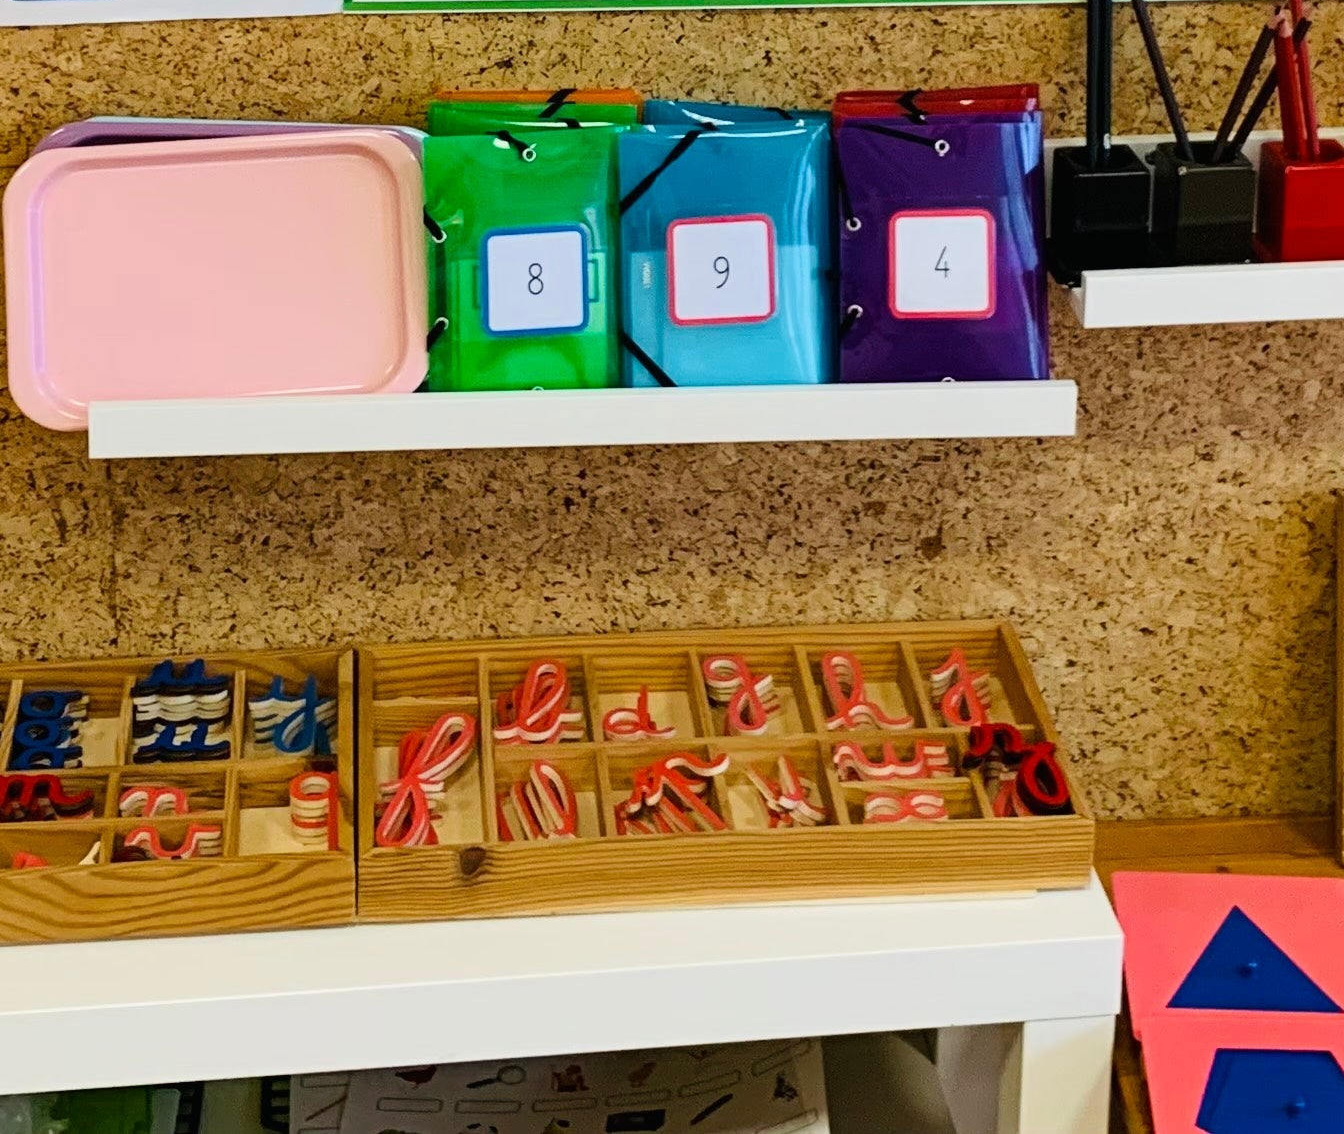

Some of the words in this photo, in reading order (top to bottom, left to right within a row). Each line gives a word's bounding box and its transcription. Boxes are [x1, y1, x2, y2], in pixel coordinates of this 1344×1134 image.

[712, 255, 730, 289] 9
[934, 245, 951, 278] 4
[527, 262, 545, 296] 8
